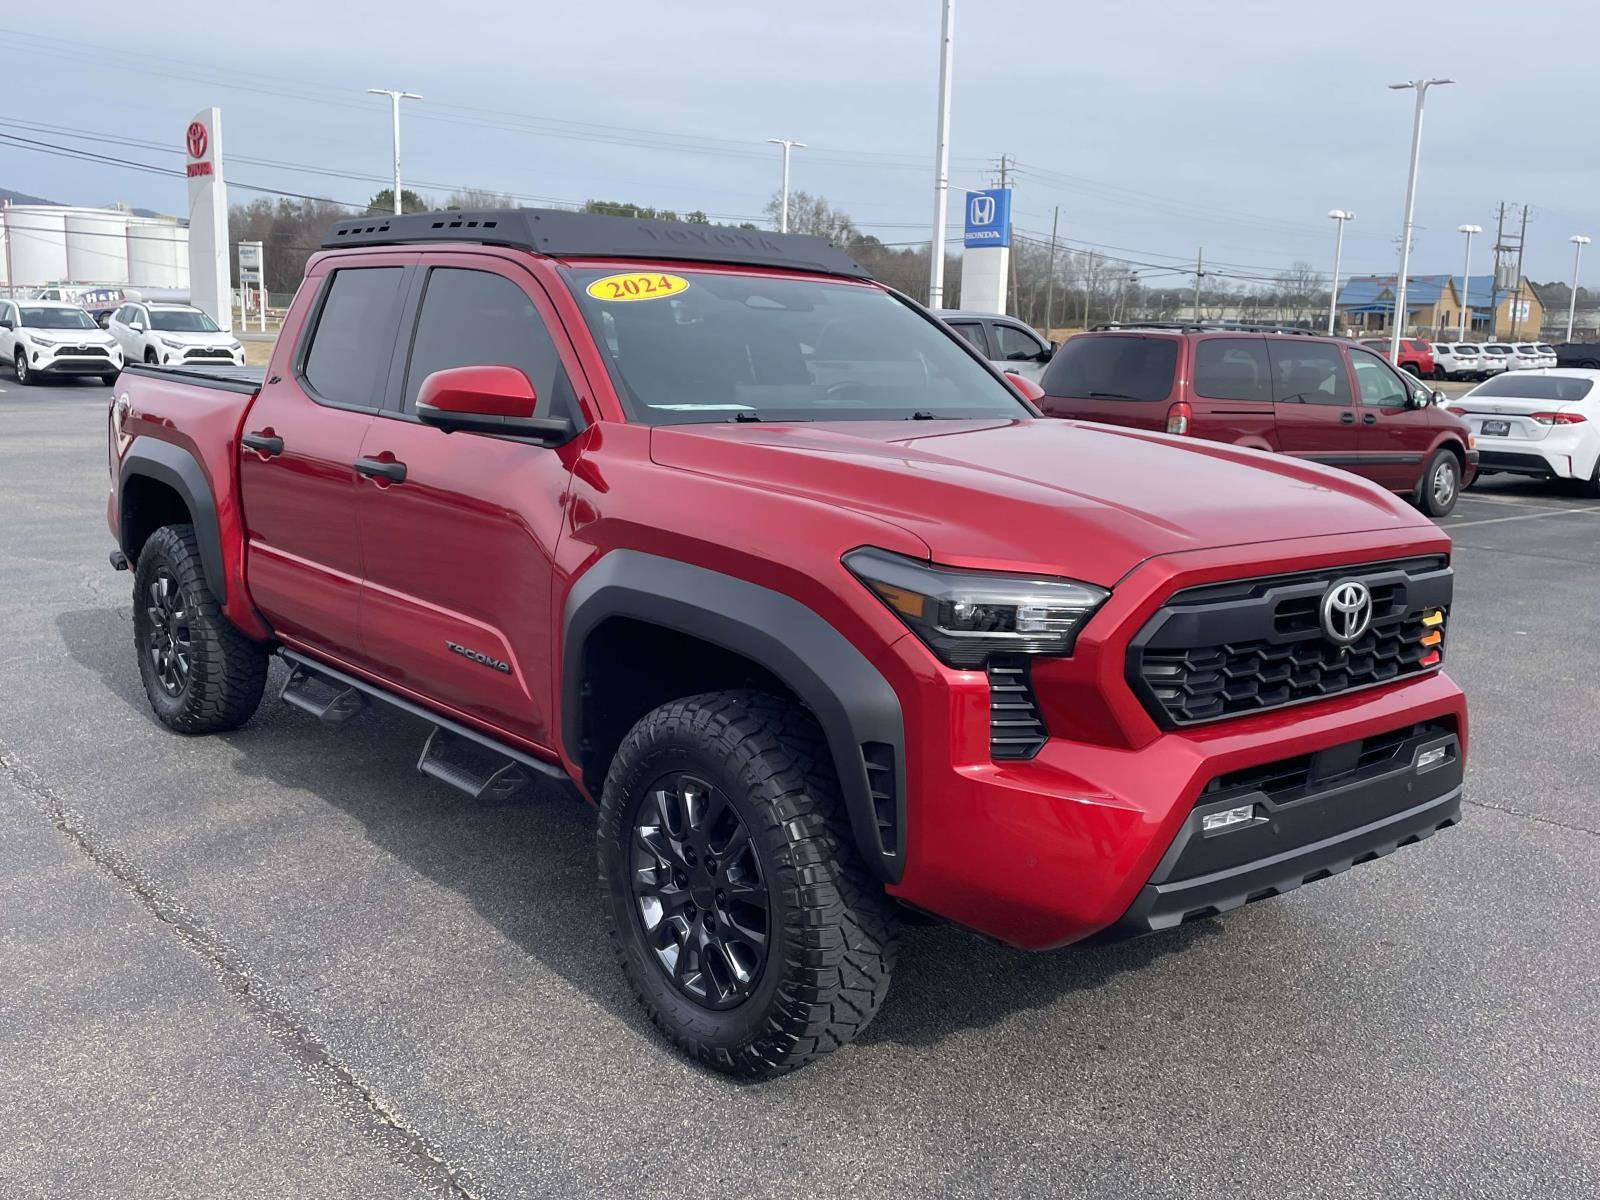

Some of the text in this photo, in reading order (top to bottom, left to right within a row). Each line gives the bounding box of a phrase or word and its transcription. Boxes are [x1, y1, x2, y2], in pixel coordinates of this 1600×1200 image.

[186, 162, 213, 177] TOYOTA
[638, 225, 782, 252] TOYOTA
[965, 231, 1000, 239] HONDA
[606, 275, 673, 299] 2024
[445, 639, 513, 675] TACOMA
